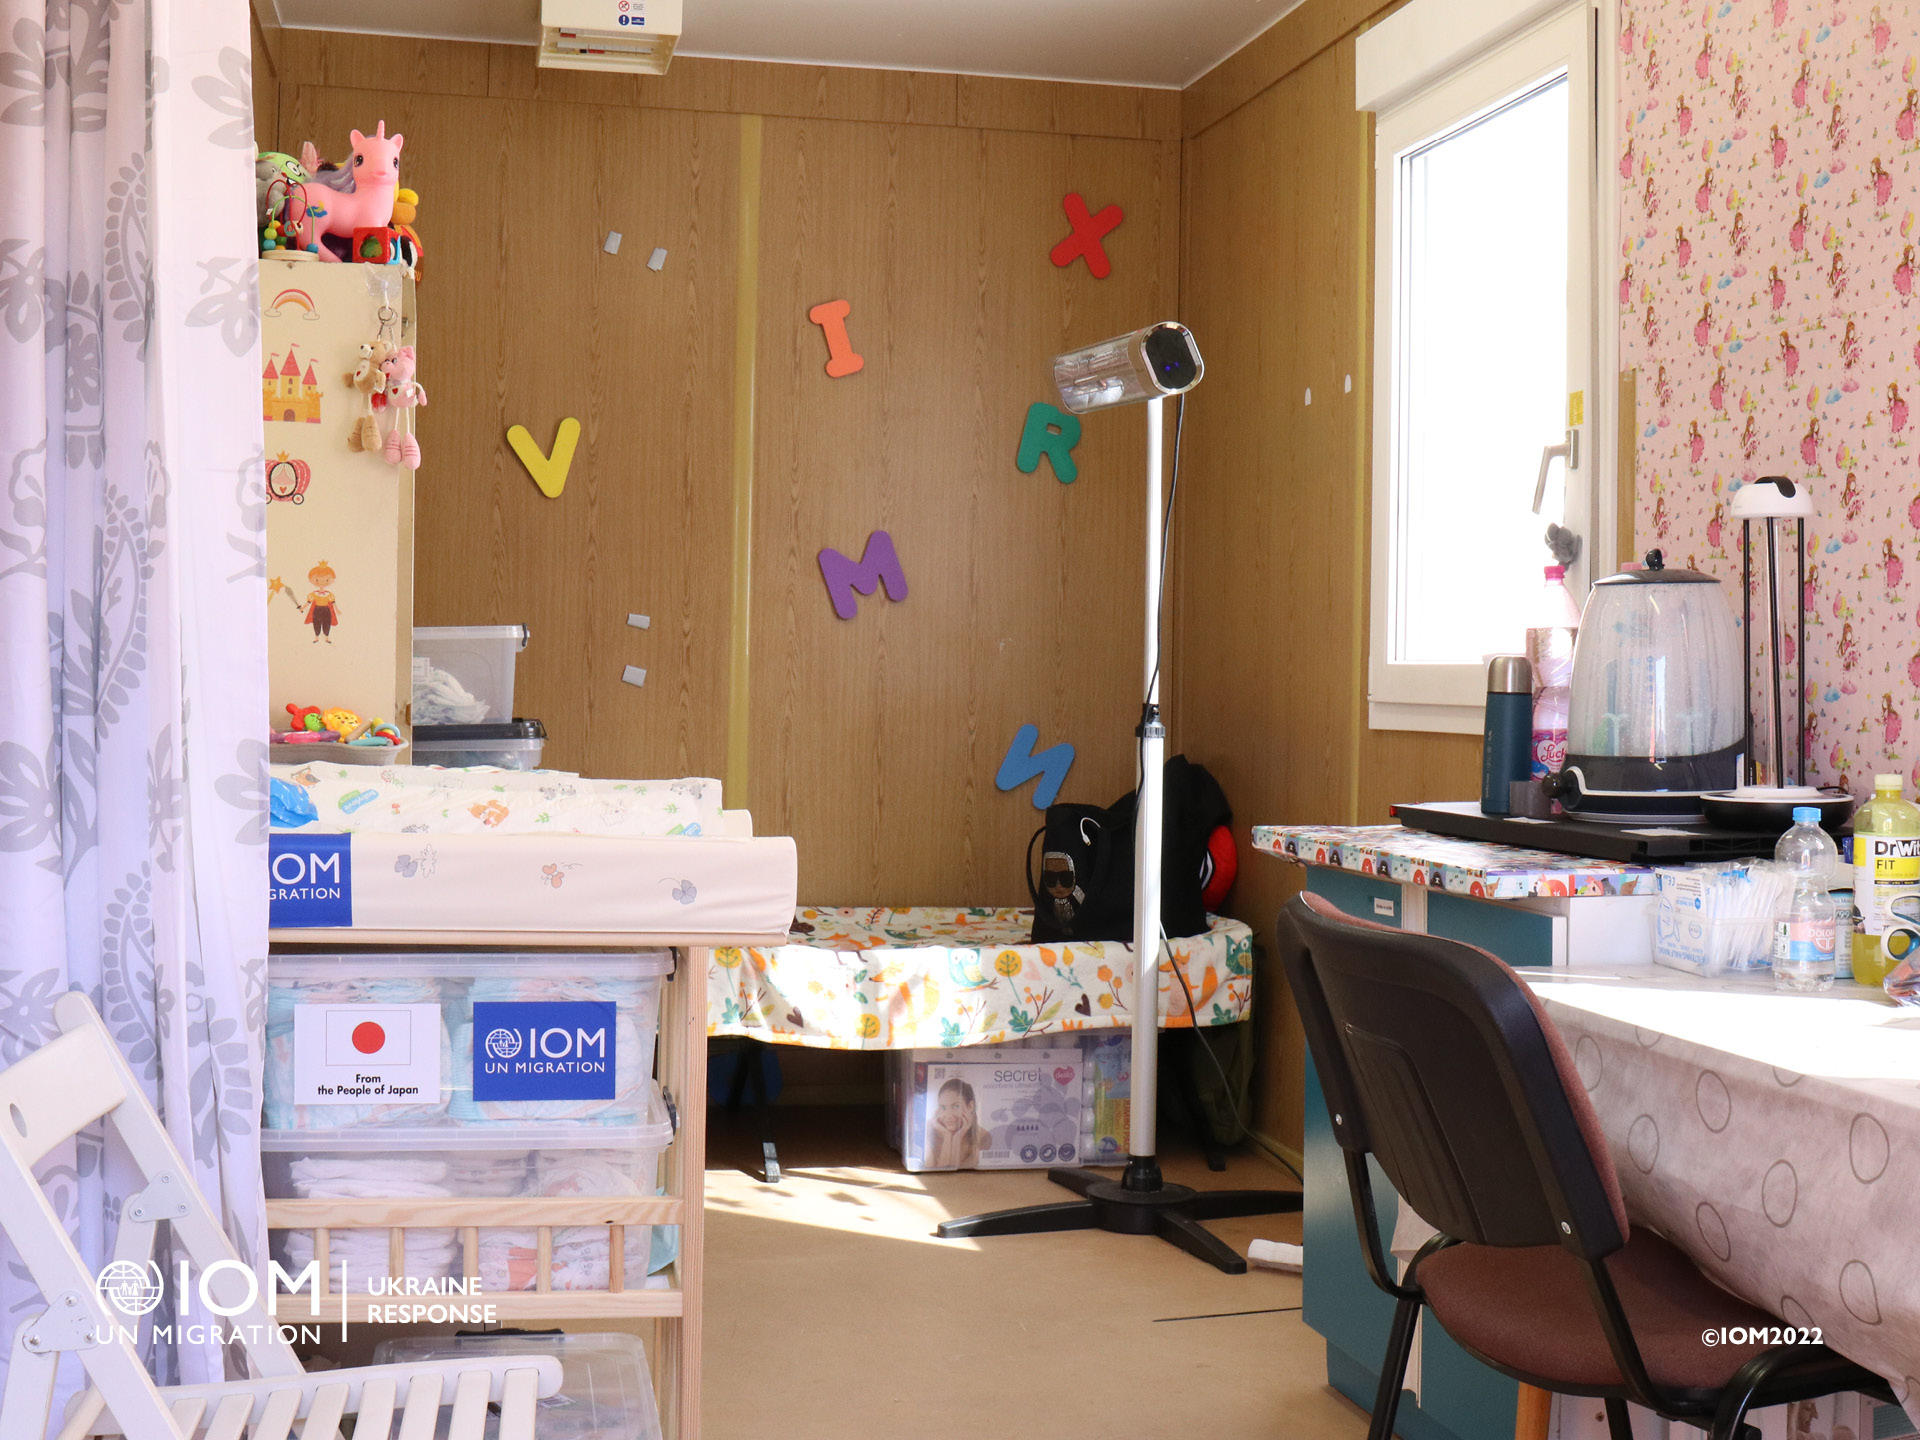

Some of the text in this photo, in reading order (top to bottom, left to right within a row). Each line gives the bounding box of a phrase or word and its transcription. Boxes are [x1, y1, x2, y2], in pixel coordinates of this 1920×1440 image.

[1050, 192, 1124, 280] X
[809, 299, 865, 378] I
[507, 417, 581, 498] V
[1017, 401, 1082, 484] R
[818, 530, 909, 620] M
[1876, 859, 1896, 870] FIT
[529, 1027, 606, 1059] IOM
[355, 1073, 381, 1084] From
[485, 1061, 605, 1074] UN MIGRATION
[994, 1067, 1042, 1083] secret
[317, 1085, 419, 1097] the People of Japan
